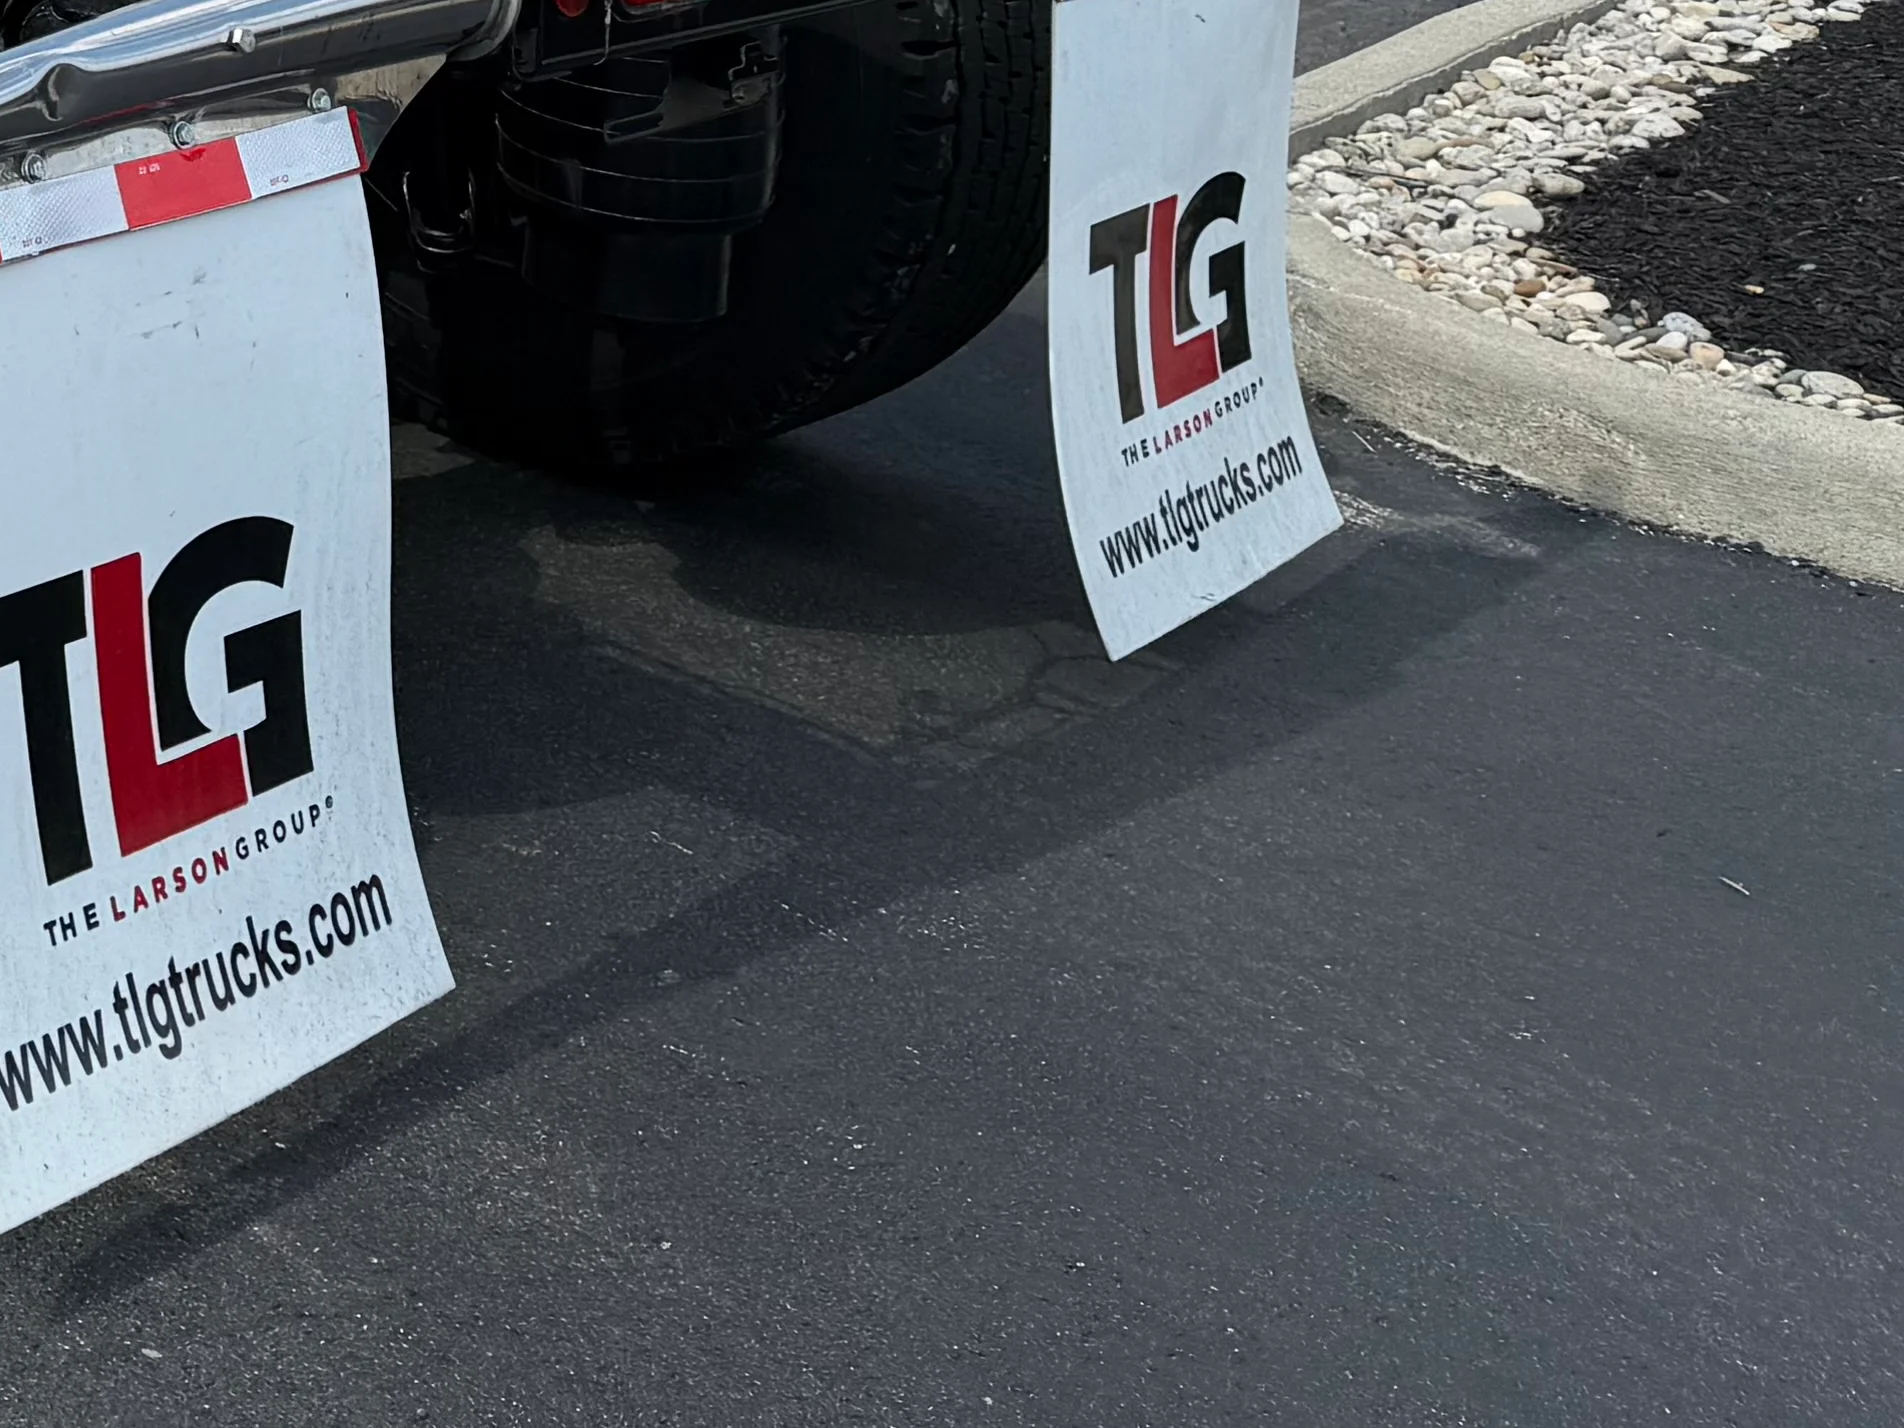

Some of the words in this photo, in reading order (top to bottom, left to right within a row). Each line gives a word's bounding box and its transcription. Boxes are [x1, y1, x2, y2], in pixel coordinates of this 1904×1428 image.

[1089, 171, 1252, 425] TLG
[1121, 438, 1150, 467] THE
[1153, 408, 1213, 454] LARSON
[1099, 435, 1302, 577] www.tlgtrucks.com
[43, 902, 100, 946] THE
[110, 847, 229, 922] LARSON
